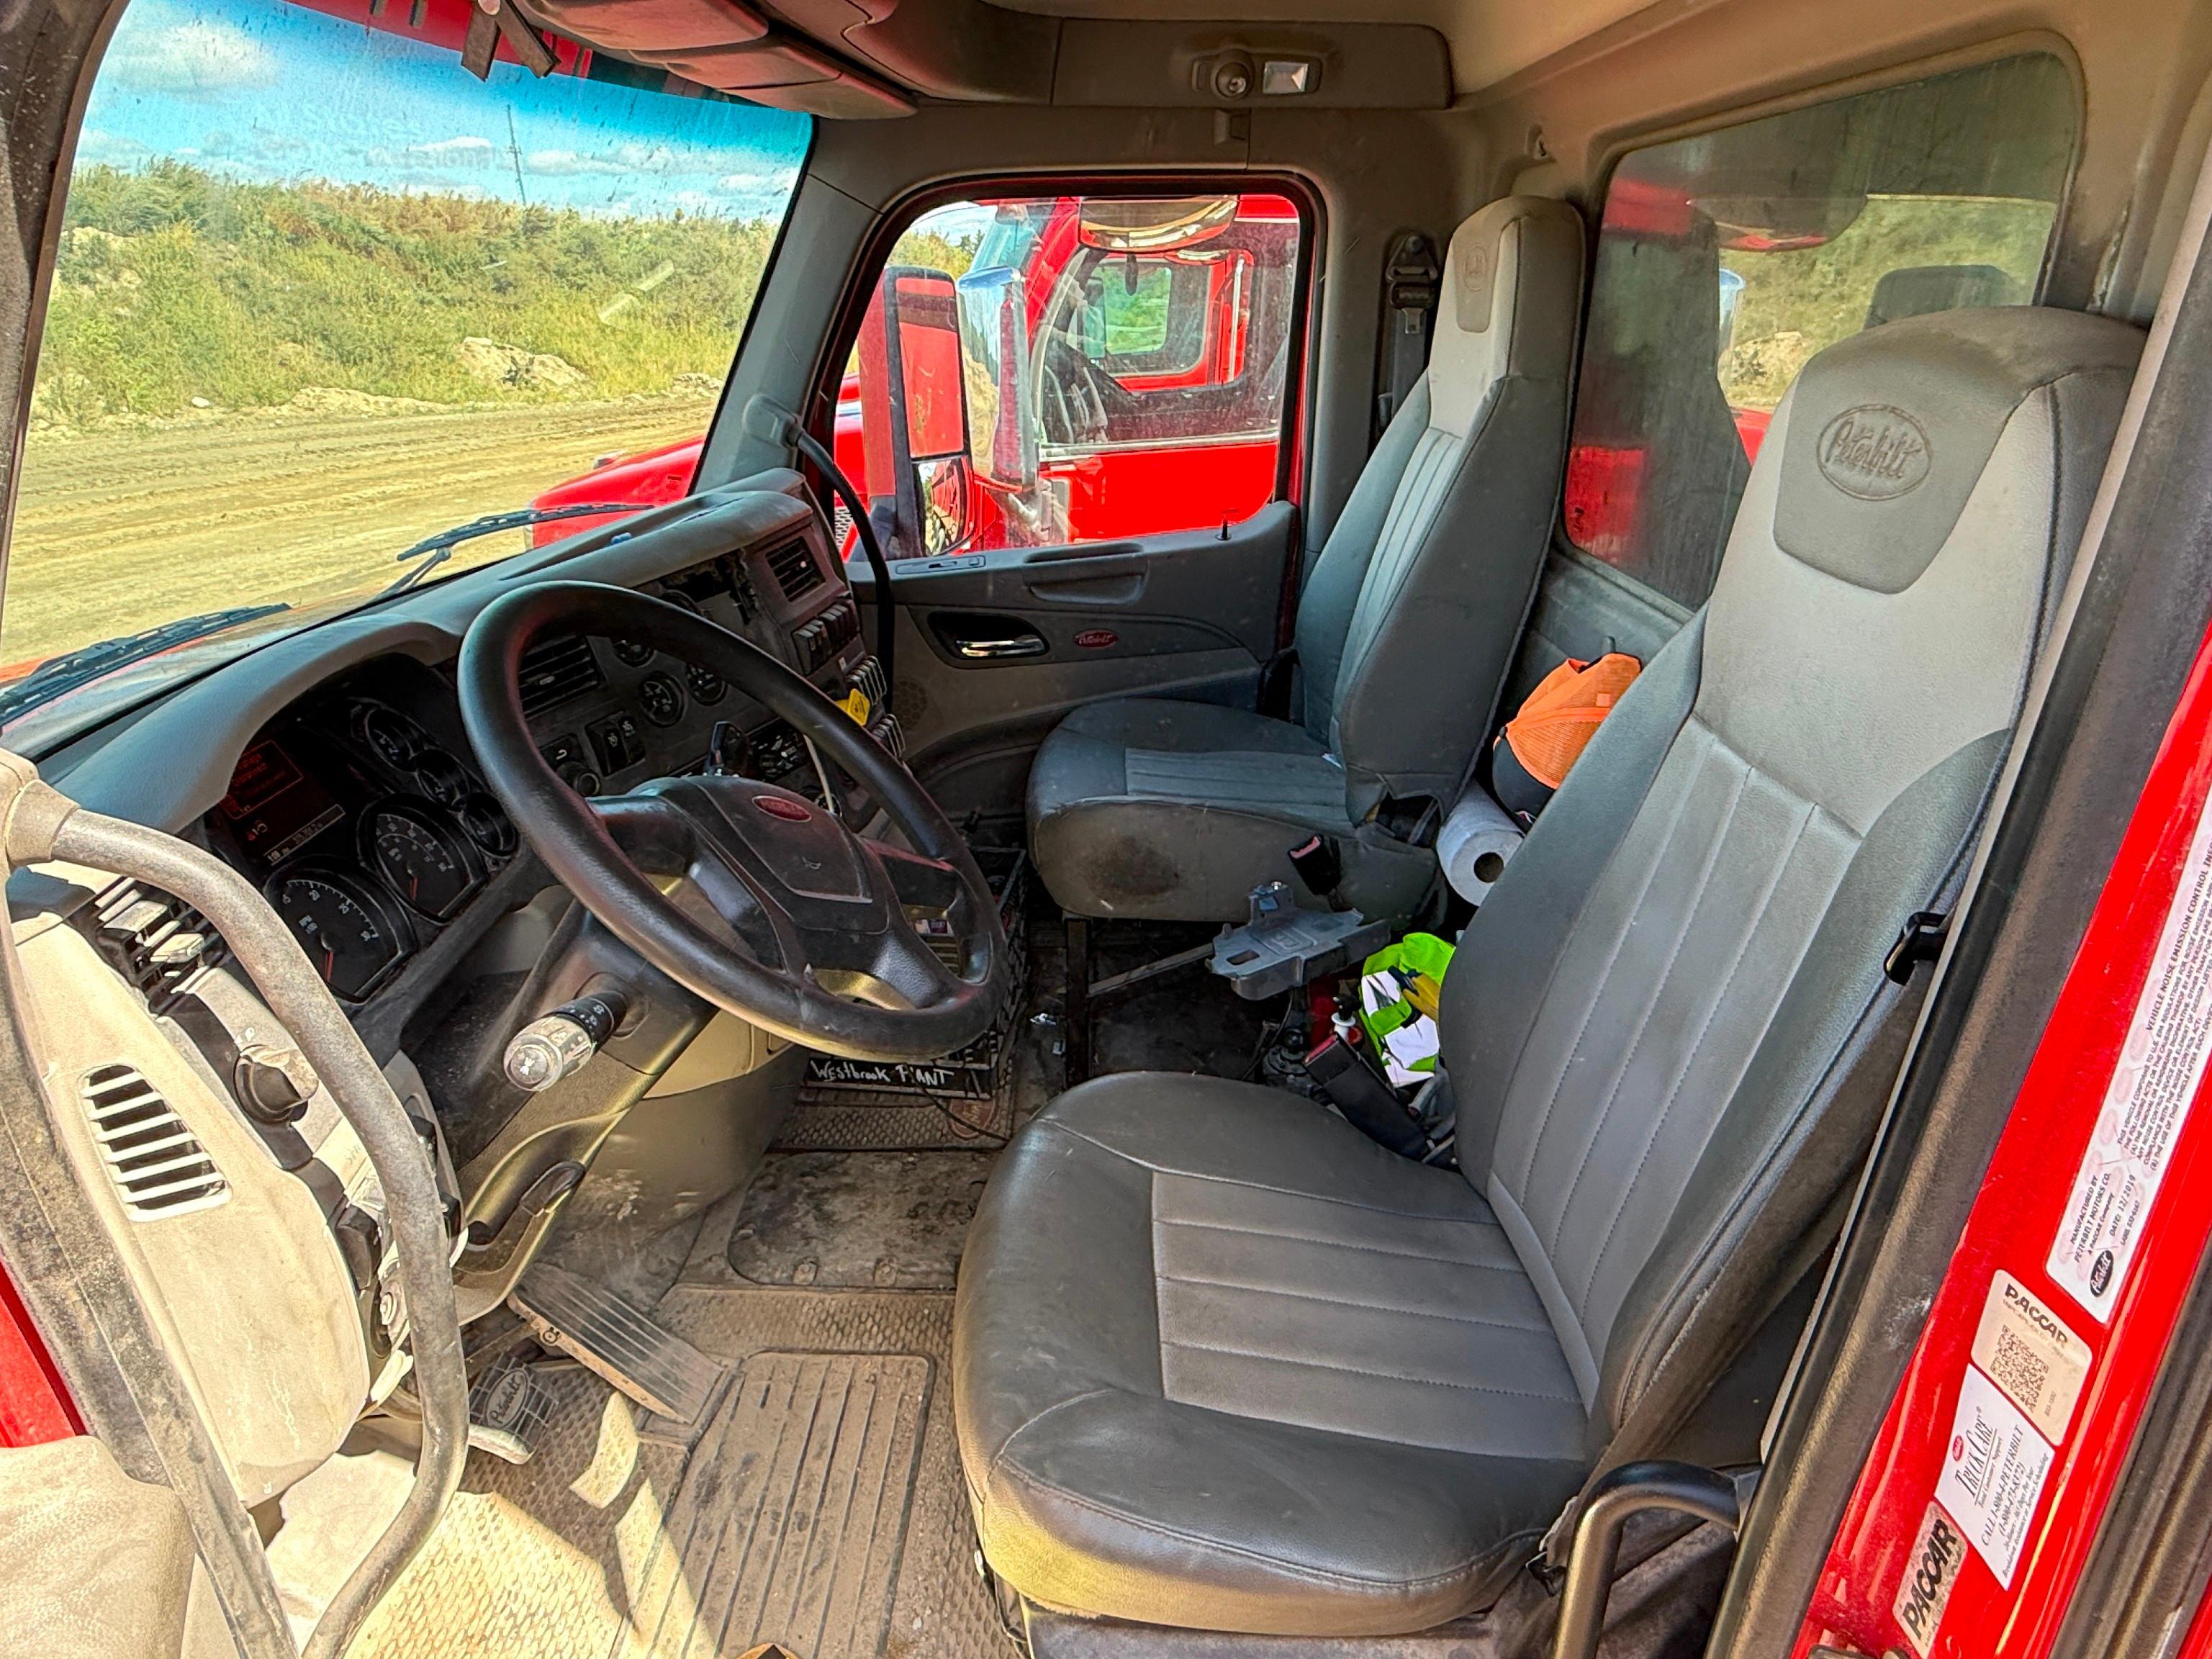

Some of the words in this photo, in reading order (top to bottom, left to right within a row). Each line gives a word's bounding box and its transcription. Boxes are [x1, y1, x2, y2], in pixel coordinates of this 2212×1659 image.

[1825, 416, 1923, 479] Peterbilt
[2146, 993, 2164, 1031] VEHICLE
[2159, 963, 2175, 993] NOISE
[2170, 915, 2192, 962] EMISSION
[2188, 870, 2208, 913] CONTROL
[2185, 964, 2194, 979] ANY
[2123, 1101, 2137, 1129] VEHICLE
[2146, 1053, 2154, 1063] TO
[2070, 1187, 2094, 1244] MANUFACTURED
[2090, 1175, 2098, 1187] BY
[2089, 1185, 2105, 1220] MOTORS
[2101, 1172, 2111, 1186] CO.
[2109, 1213, 2121, 1237] DATE:
[2089, 1223, 2103, 1249] PACCAR
[2005, 1283, 2068, 1347] PACCAR
[1981, 1517, 1996, 1546] CALL
[1903, 1519, 1956, 1638] PACCAR
